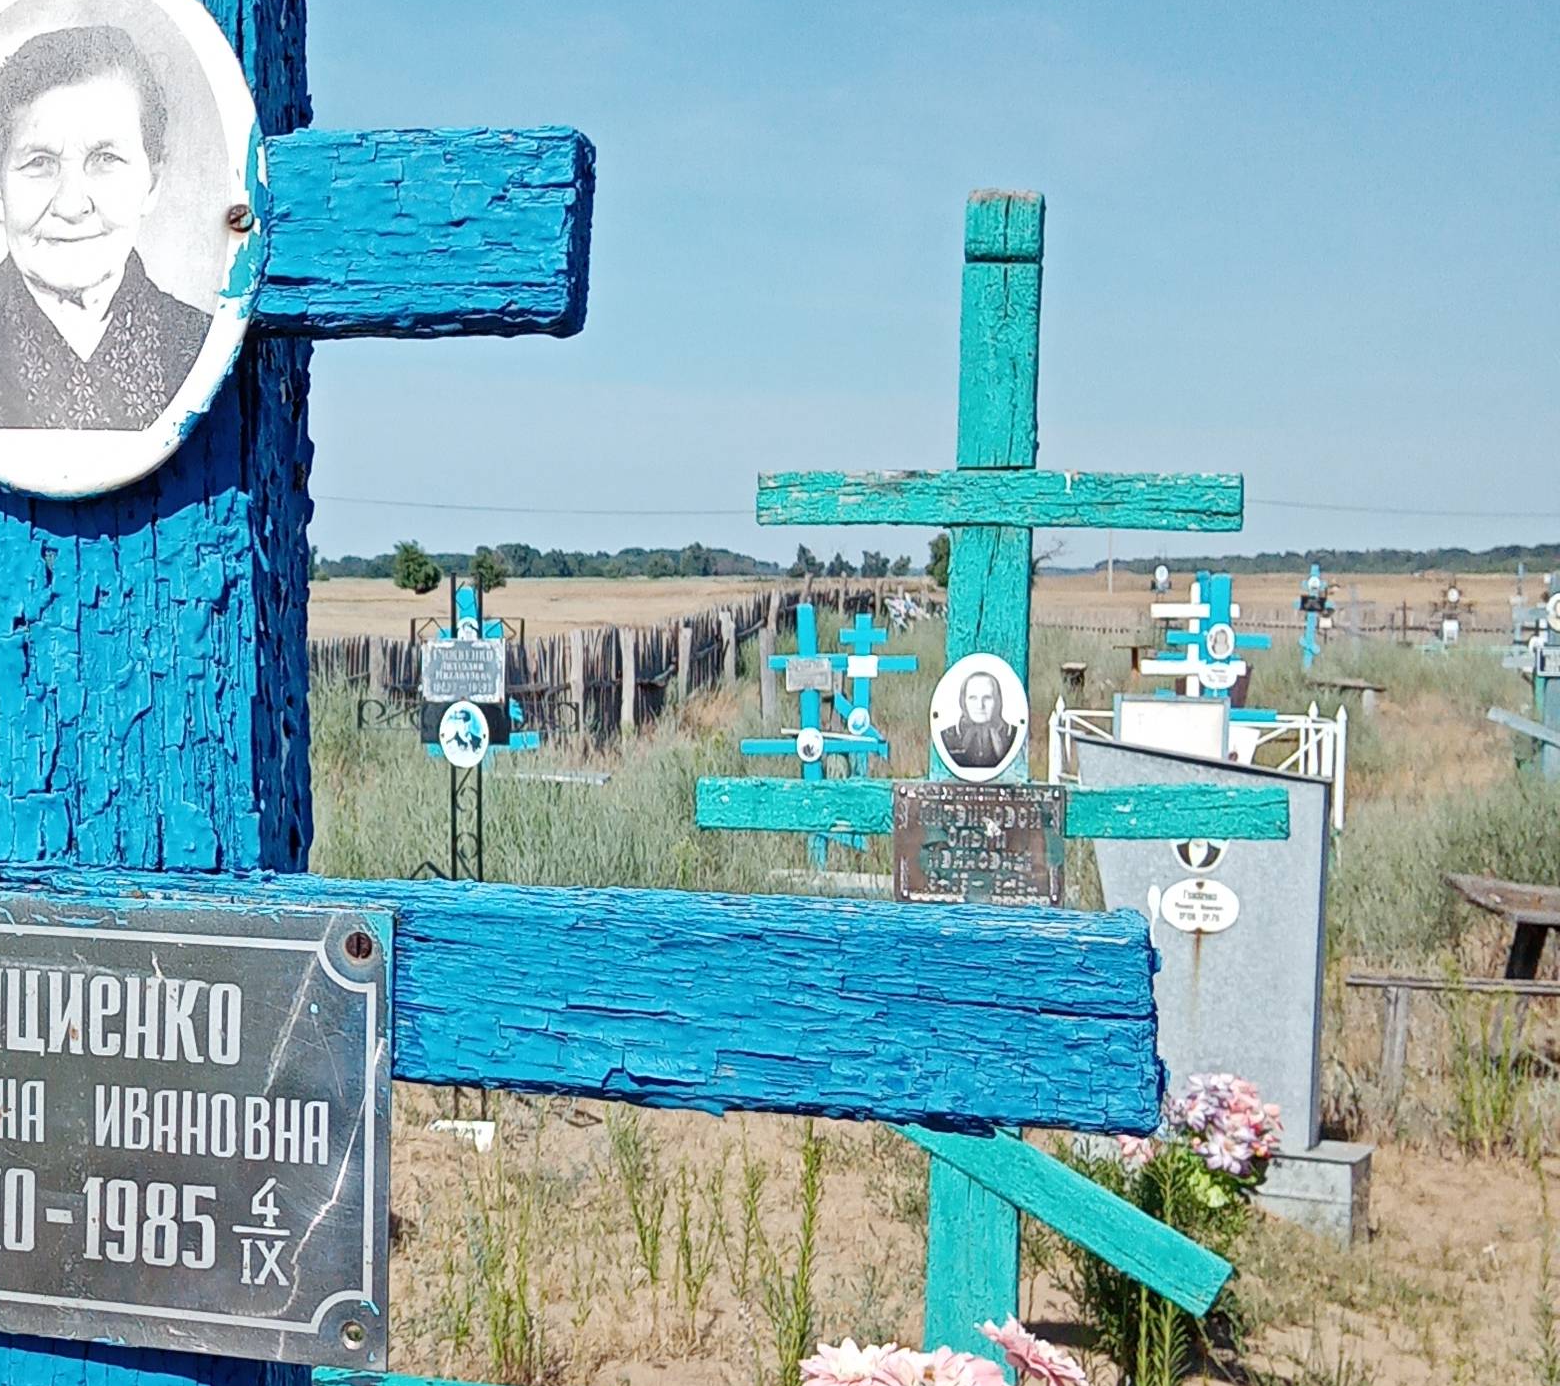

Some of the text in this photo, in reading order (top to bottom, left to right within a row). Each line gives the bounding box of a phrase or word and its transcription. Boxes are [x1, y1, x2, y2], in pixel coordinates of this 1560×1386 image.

[95, 1084, 329, 1165] ИВАНОВНА
[251, 1177, 281, 1228] 4
[240, 1238, 290, 1287] IX
